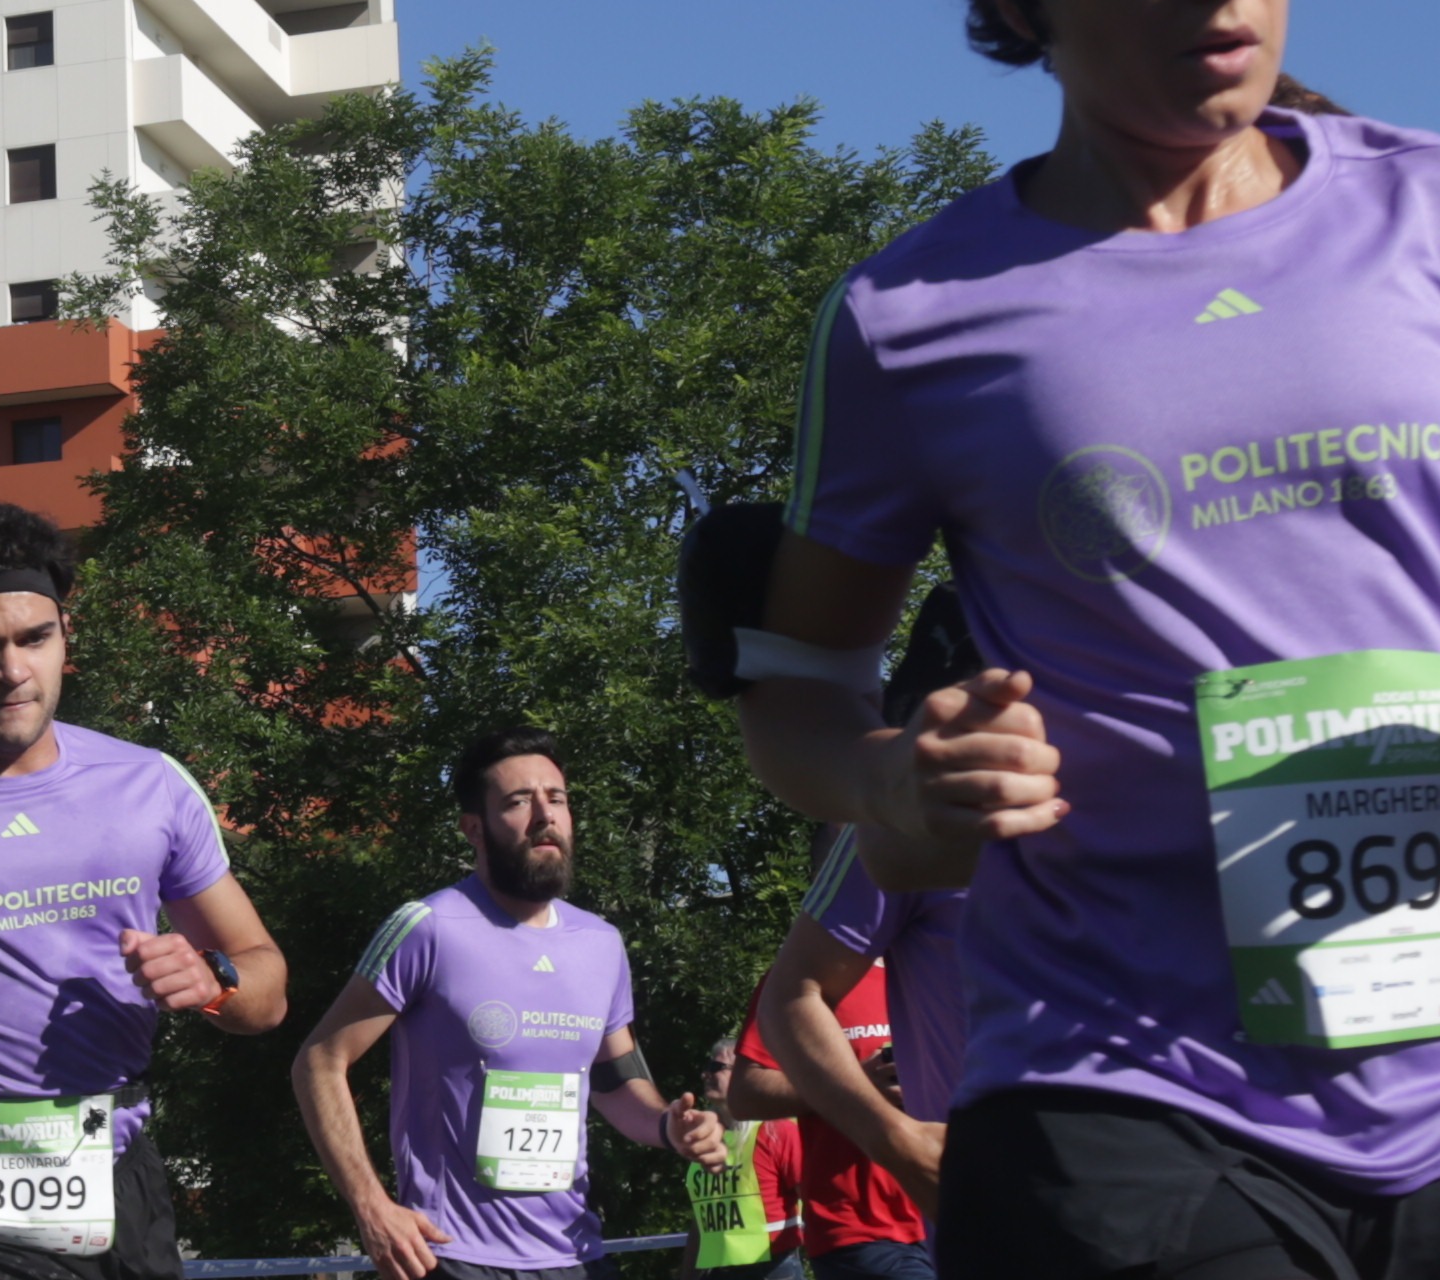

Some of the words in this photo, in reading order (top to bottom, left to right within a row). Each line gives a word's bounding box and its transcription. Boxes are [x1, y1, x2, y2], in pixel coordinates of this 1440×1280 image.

[1191, 481, 1324, 530] MILANO
[1329, 472, 1400, 504] 1863
[61, 905, 97, 922] 1863
[522, 1010, 604, 1031] POLITECNICO
[522, 1028, 558, 1040] MILANO
[504, 1127, 563, 1154] 1277
[693, 1165, 743, 1197] STAFF
